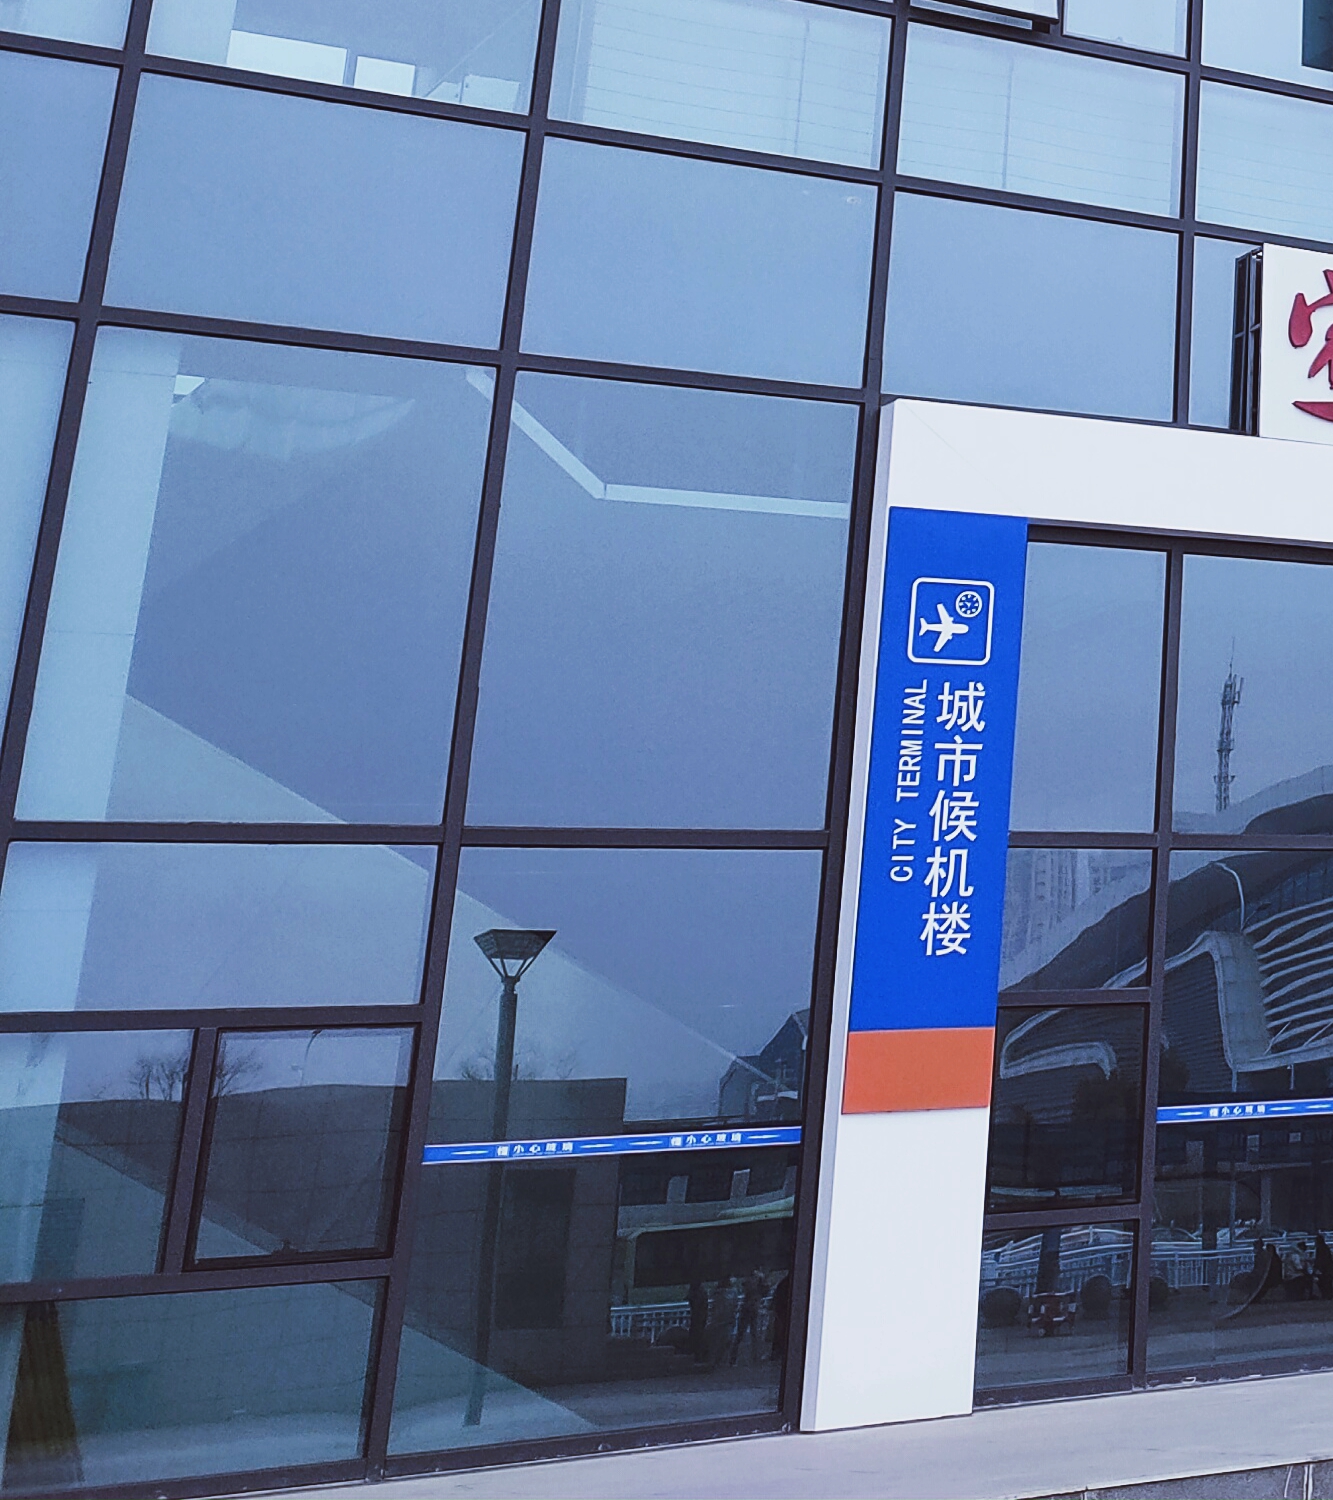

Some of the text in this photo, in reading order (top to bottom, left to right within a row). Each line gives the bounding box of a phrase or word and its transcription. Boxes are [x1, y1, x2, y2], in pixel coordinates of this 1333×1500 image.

[889, 678, 929, 883] CITY TERMINAL
[919, 681, 986, 957] 城市候机楼
